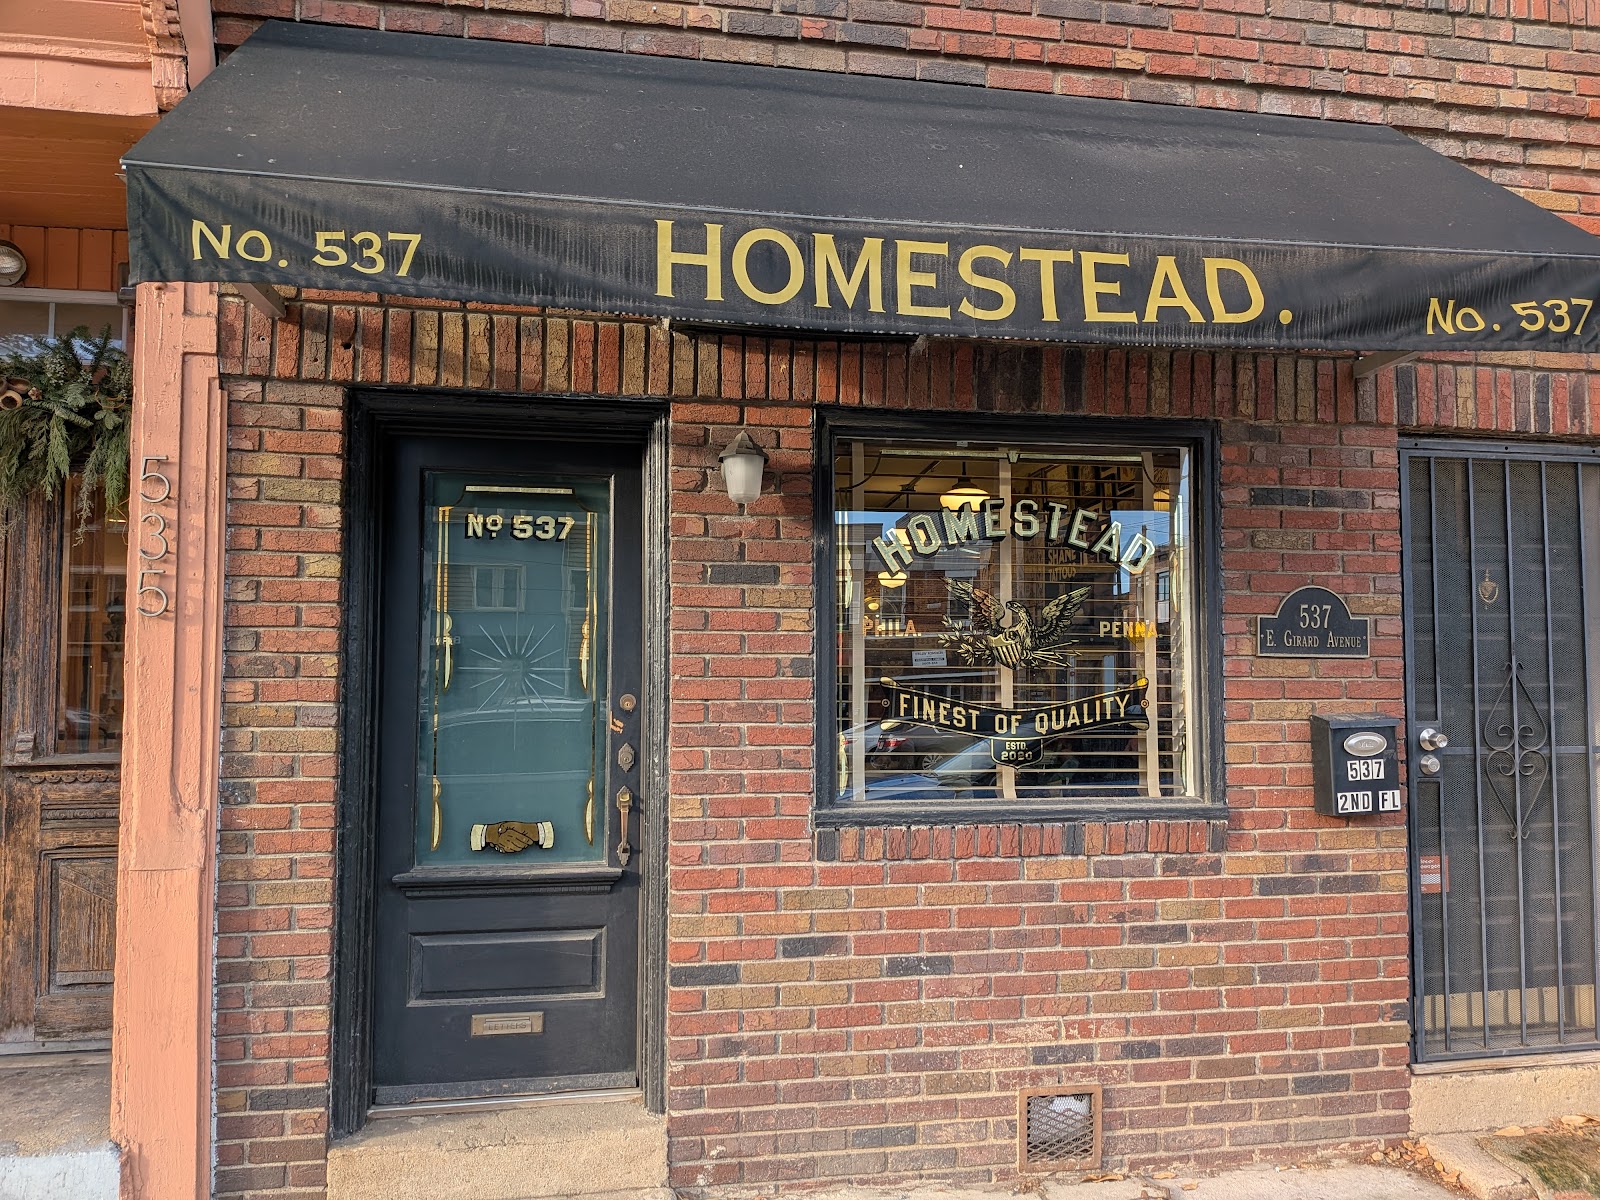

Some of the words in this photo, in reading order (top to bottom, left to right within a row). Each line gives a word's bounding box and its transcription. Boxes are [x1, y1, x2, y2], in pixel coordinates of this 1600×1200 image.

[311, 229, 422, 277] 537
[653, 219, 1293, 326] HOMESTEAD.
[1511, 297, 1594, 336] 537
[137, 456, 170, 617] 535
[512, 514, 576, 540] 537
[871, 498, 1156, 576] HOMESTEAD
[863, 618, 922, 637] PHILA.
[1299, 604, 1332, 629] 537
[1099, 621, 1163, 638] PENNA.
[1265, 629, 1277, 647] E.
[899, 693, 980, 731] FINEST
[994, 713, 1023, 735] OF
[1034, 693, 1131, 736] QUALITY
[1000, 750, 1033, 761] 2020
[1005, 741, 1028, 751] ESTD.
[1349, 760, 1382, 780] 537
[1339, 792, 1371, 812] 2ND
[1381, 791, 1399, 809] FL
[488, 1022, 527, 1031] LETTERS
